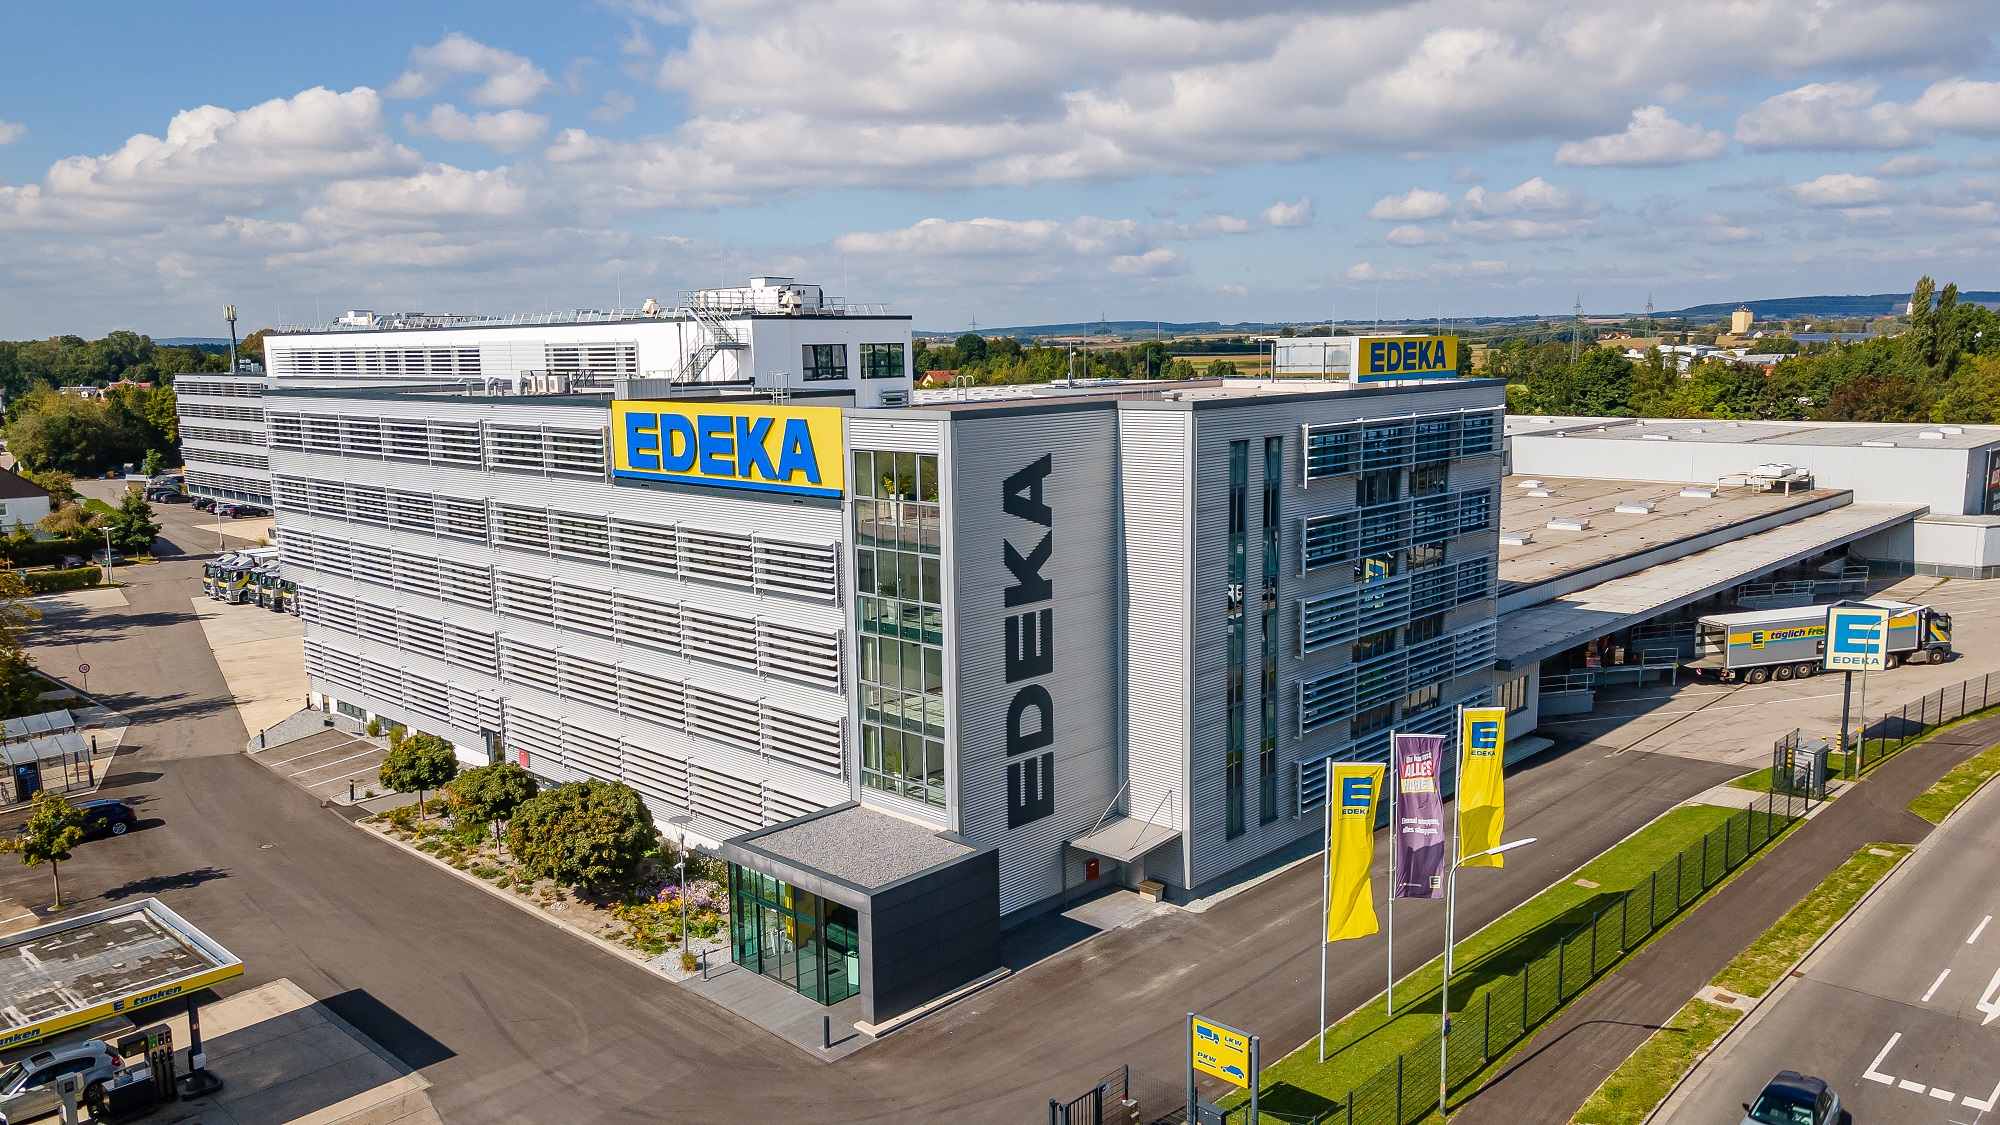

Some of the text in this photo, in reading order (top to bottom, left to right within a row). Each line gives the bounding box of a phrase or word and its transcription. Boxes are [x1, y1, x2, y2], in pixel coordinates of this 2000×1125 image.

[1370, 341, 1446, 373] EDEKA
[625, 412, 821, 485] EDEKA
[1002, 453, 1055, 830] EDEKA
[1834, 614, 1881, 654] E
[1832, 656, 1880, 665] EDEKA
[1472, 722, 1497, 748] E
[1405, 760, 1432, 777] ALLES
[1343, 777, 1372, 806] E
[114, 986, 182, 1011] E tanken
[1224, 1036, 1242, 1046] LKW
[1197, 1052, 1216, 1062] PKW
